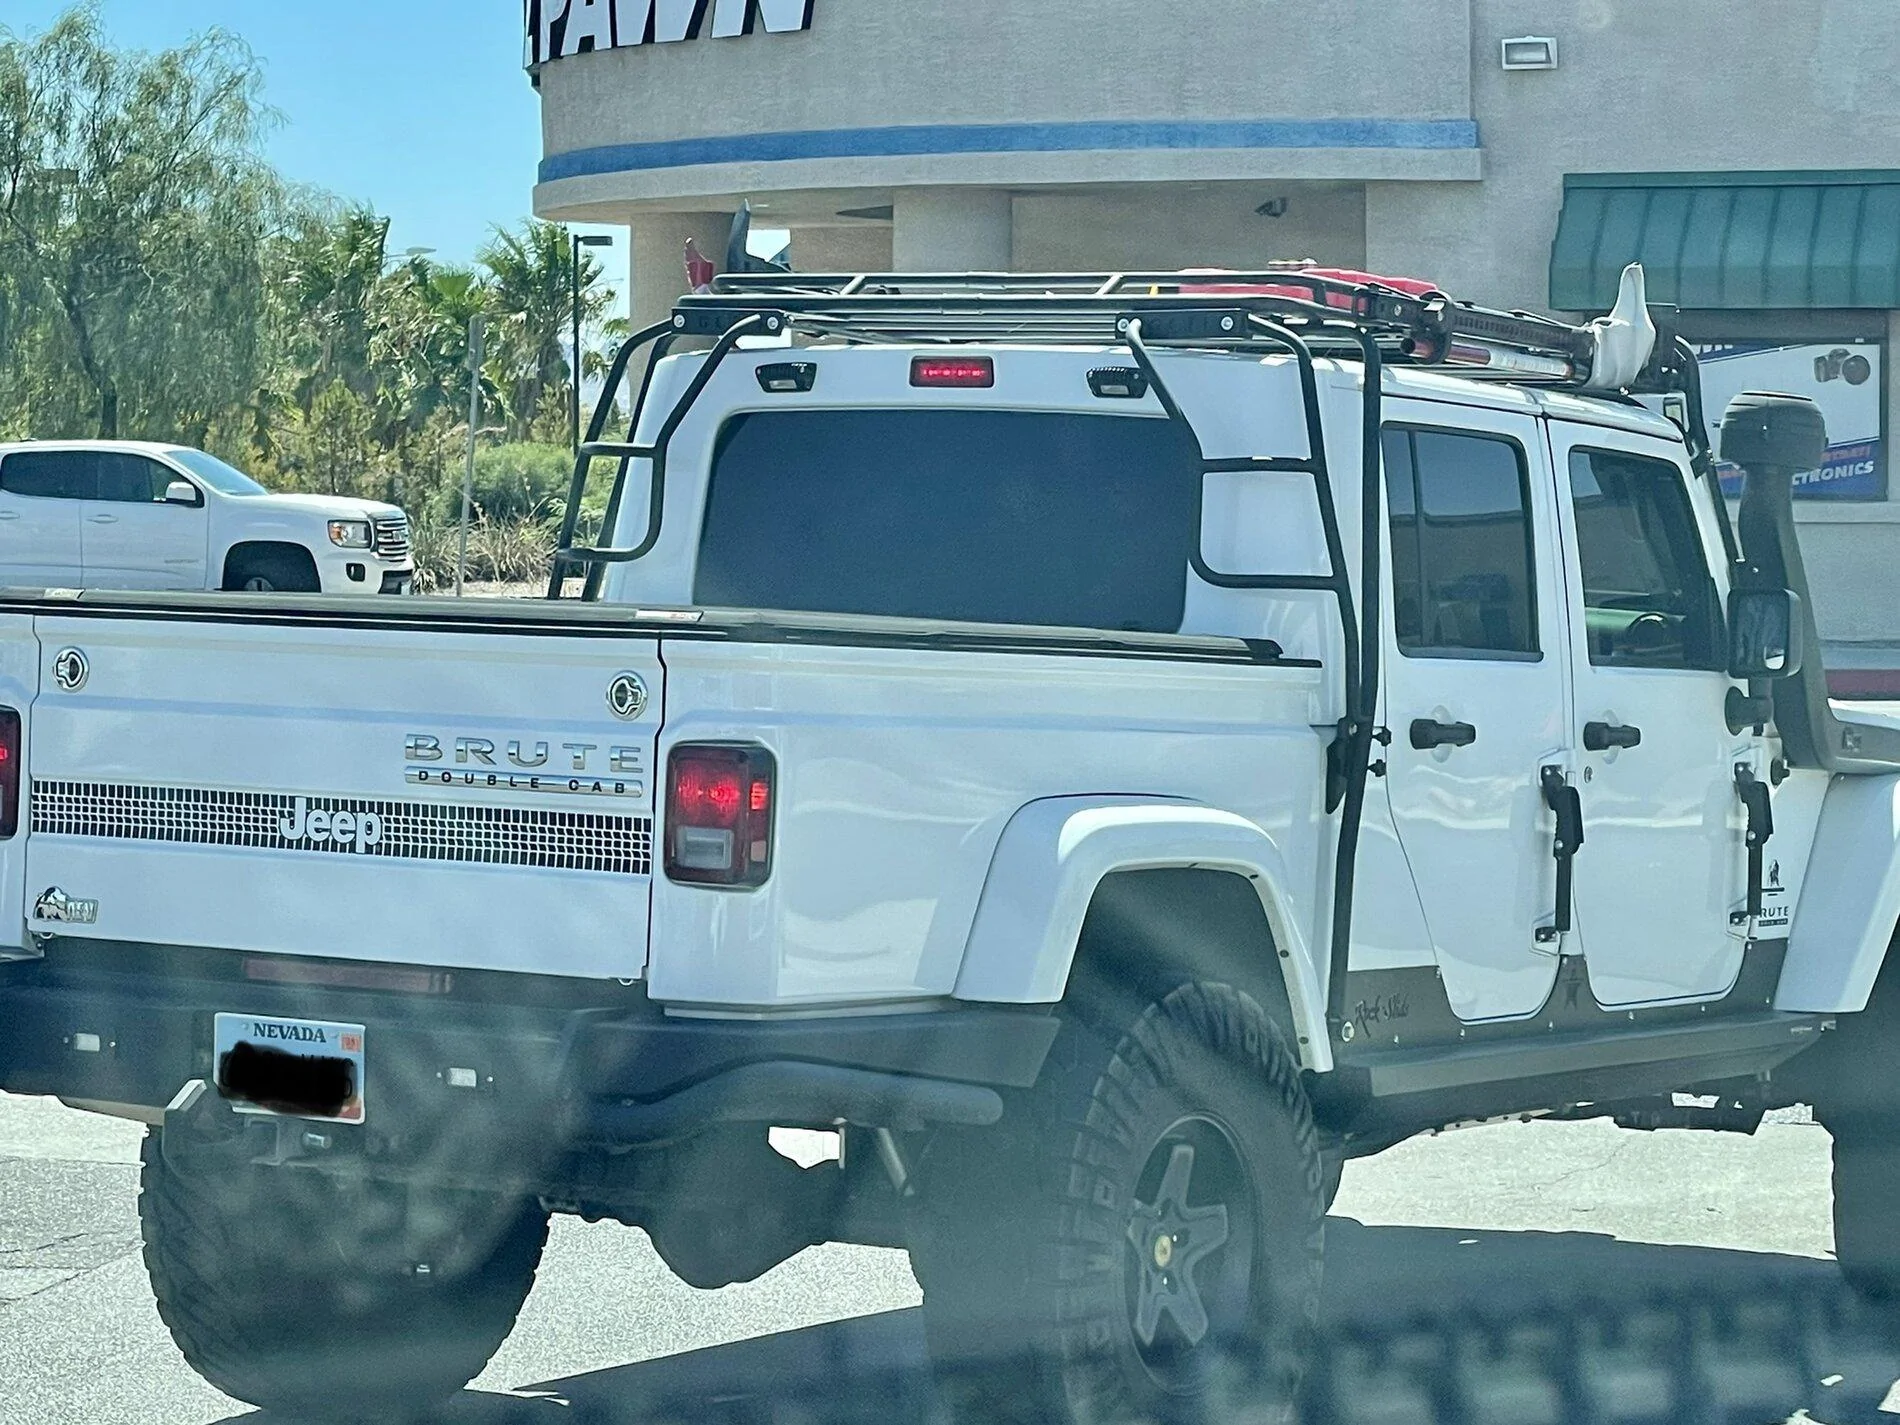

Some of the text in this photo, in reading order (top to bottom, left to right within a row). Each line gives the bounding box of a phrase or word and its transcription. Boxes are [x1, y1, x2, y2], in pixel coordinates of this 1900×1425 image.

[523, 0, 812, 65] PAWN
[1792, 460, 1875, 486] CTRONICS
[404, 733, 644, 773] BRUTE
[418, 770, 626, 794] DOUBLE CAB
[278, 796, 383, 853] Jeep
[1760, 906, 1789, 918] RUTE
[253, 1022, 327, 1043] NEVADA
